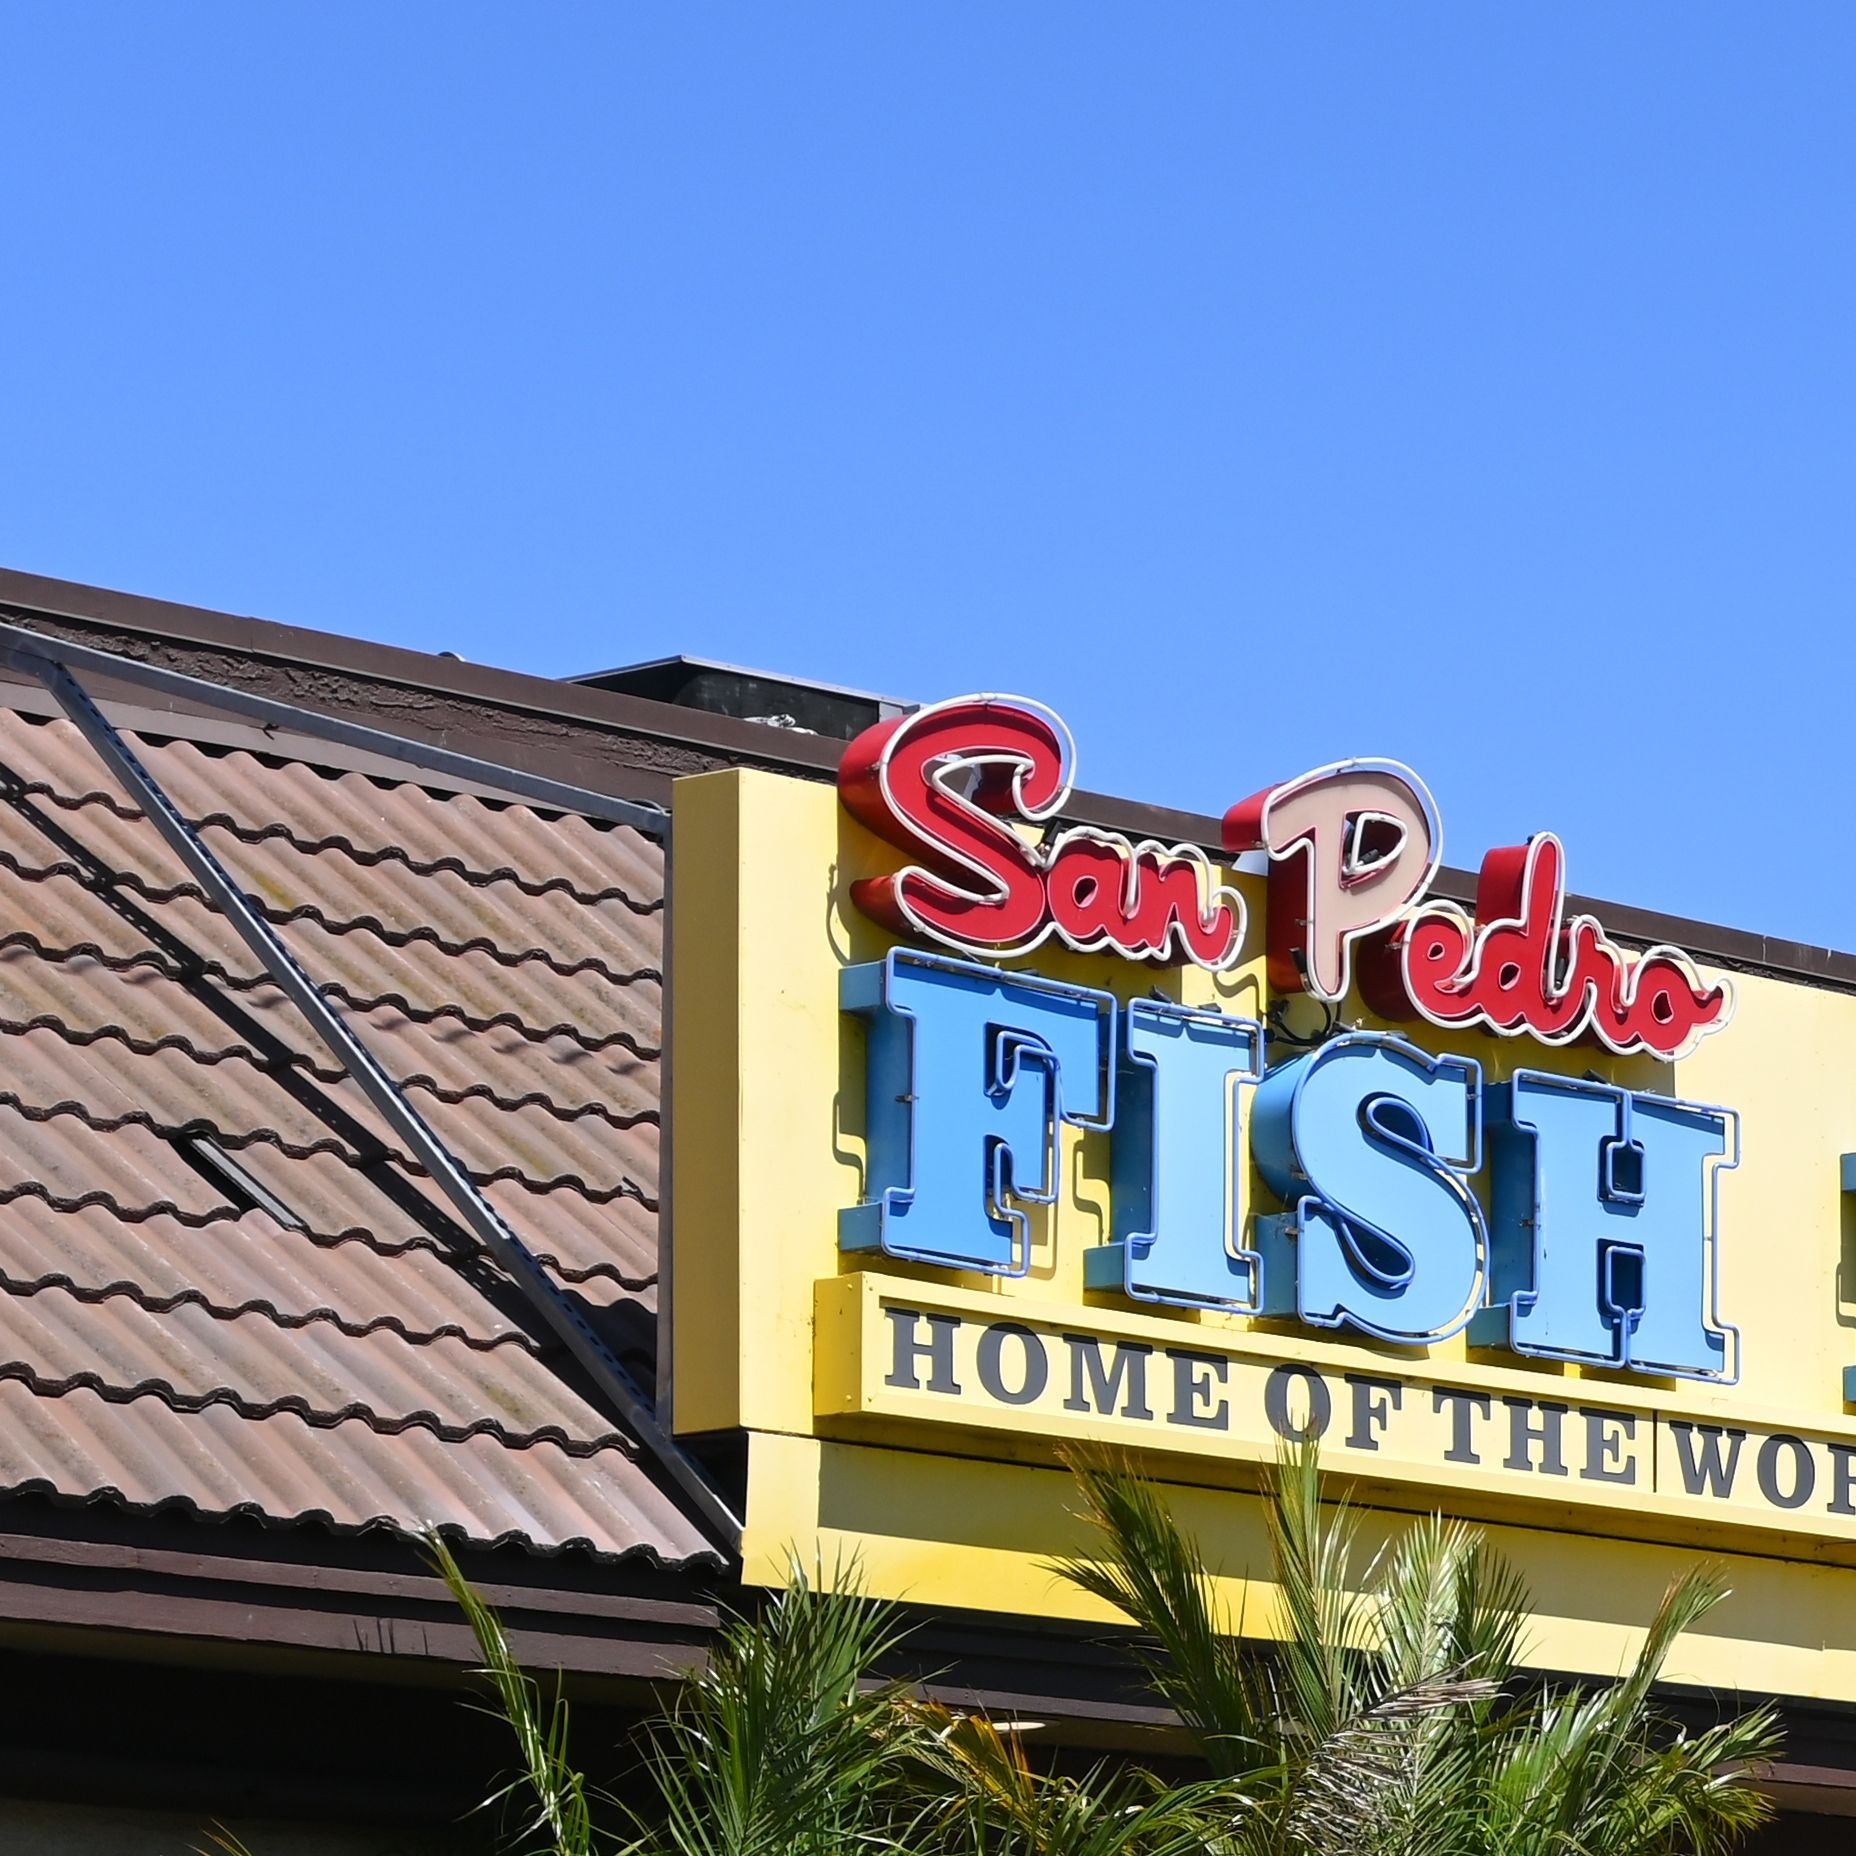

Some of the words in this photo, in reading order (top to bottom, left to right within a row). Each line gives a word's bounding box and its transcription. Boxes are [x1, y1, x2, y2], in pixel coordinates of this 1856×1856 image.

[878, 692, 1249, 971] San
[1240, 756, 1736, 1060] Pedro
[860, 944, 1740, 1387] FISH
[883, 1306, 1229, 1432] HOME
[1263, 1362, 1402, 1450] OF
[1431, 1384, 1636, 1485] THE
